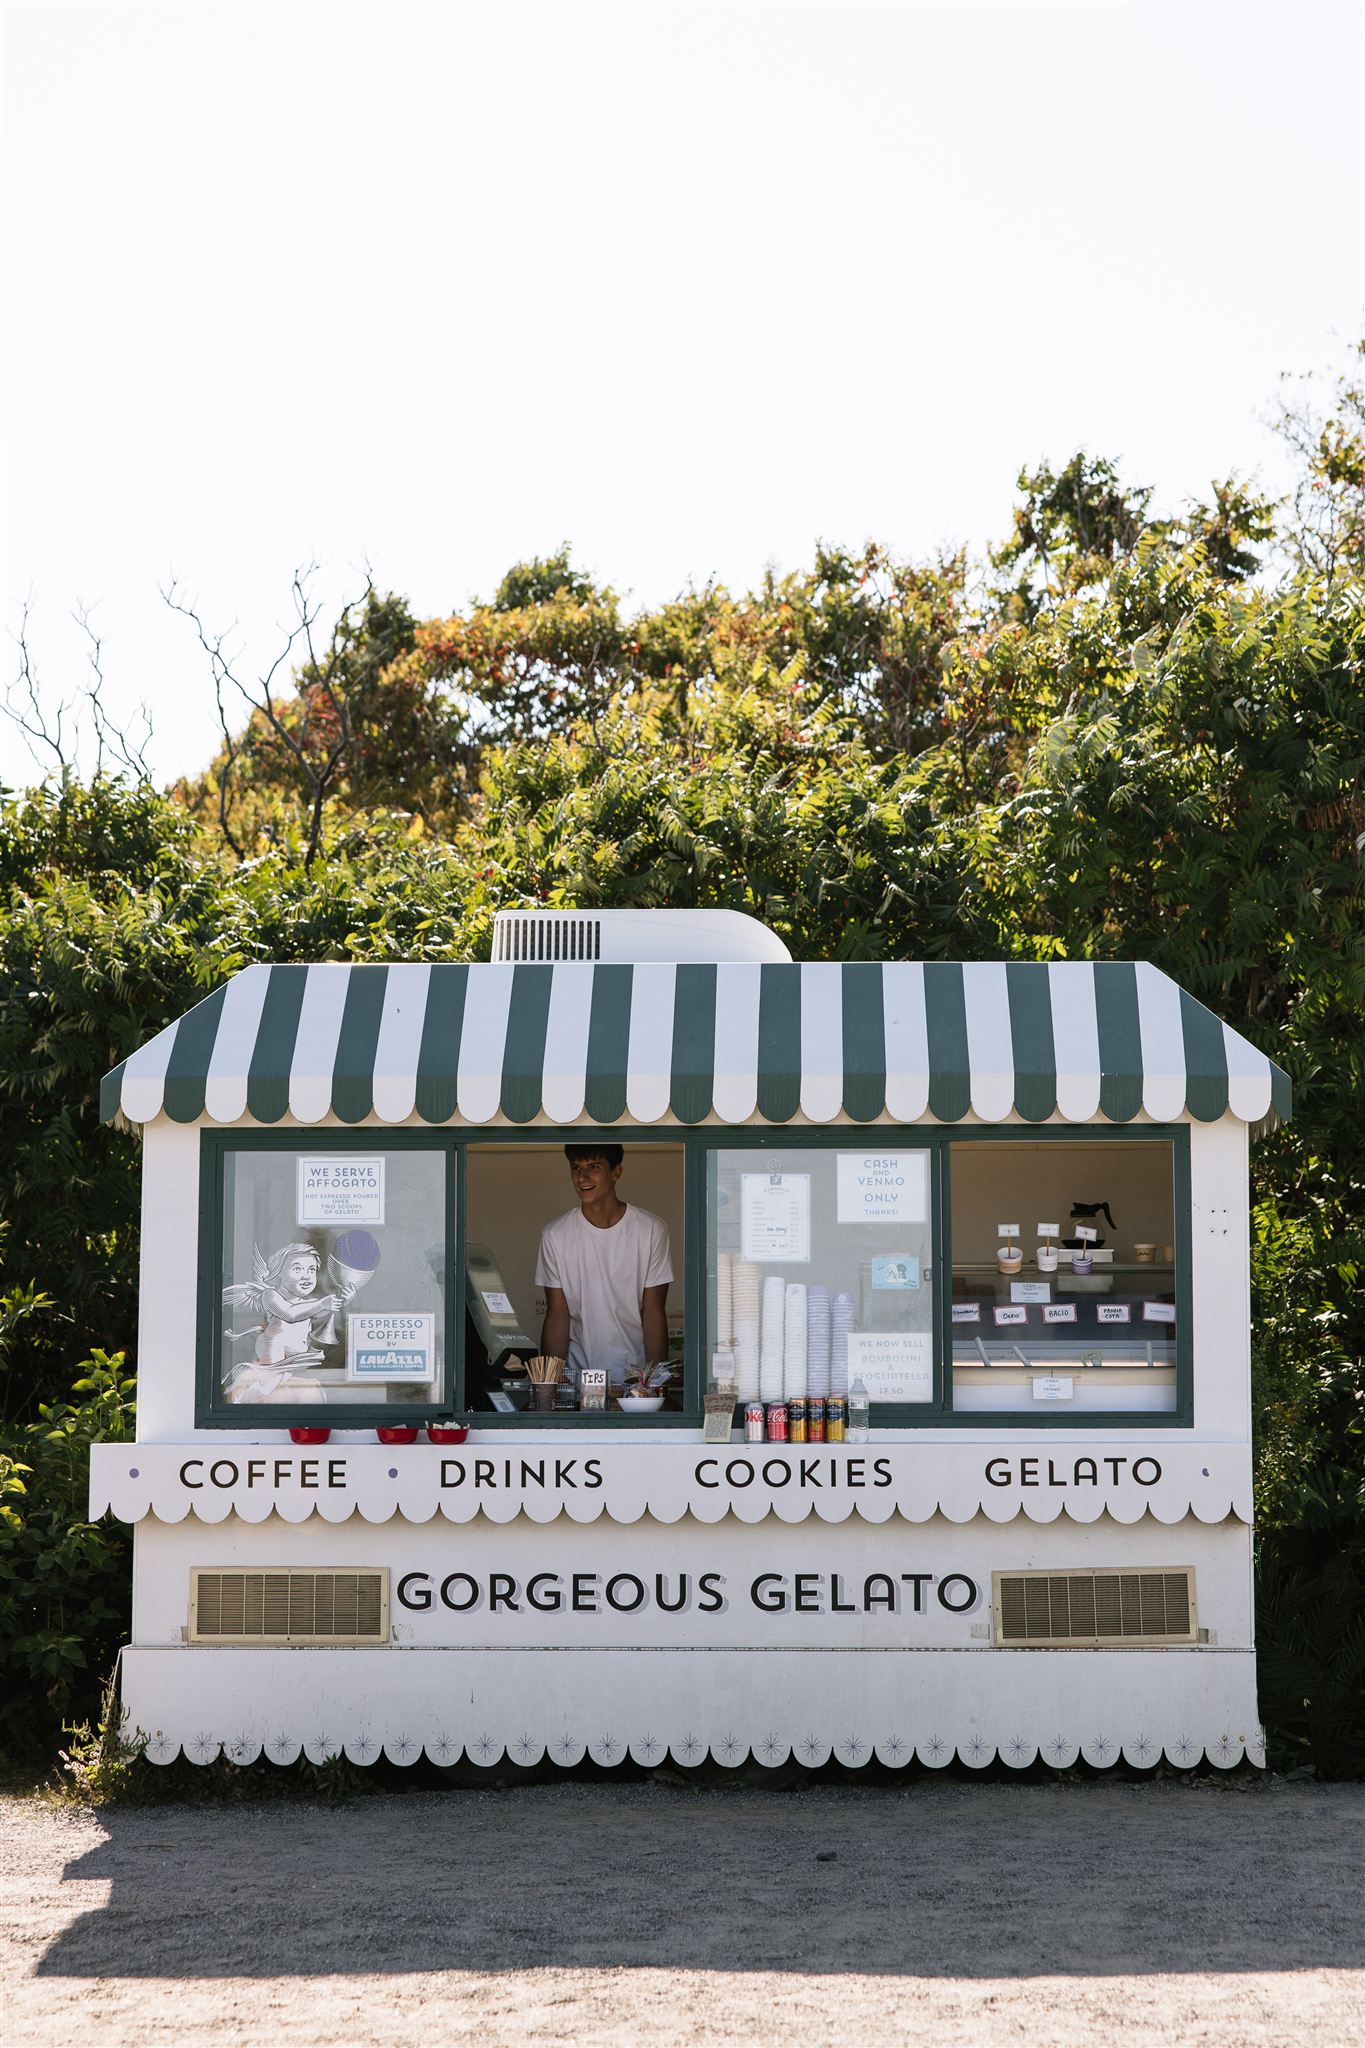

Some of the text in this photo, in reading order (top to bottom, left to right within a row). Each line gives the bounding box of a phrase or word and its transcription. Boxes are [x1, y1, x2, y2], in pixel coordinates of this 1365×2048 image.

[864, 1160, 898, 1168] CASH
[310, 1168, 373, 1176] WE SERVE
[307, 1178, 377, 1188] AFFOGATO
[858, 1177, 904, 1186] VENMO
[865, 1193, 898, 1202] ONLY
[361, 1319, 423, 1328] ESPRESSO
[367, 1330, 416, 1339] COFFEE
[583, 1372, 604, 1383] TIPS
[180, 1460, 347, 1489] COFFEE
[441, 1459, 603, 1489] DRINKS
[694, 1458, 893, 1488] COOKIES
[985, 1457, 1162, 1487] GELATO
[397, 1572, 981, 1615] GORGEOUS GELATO
